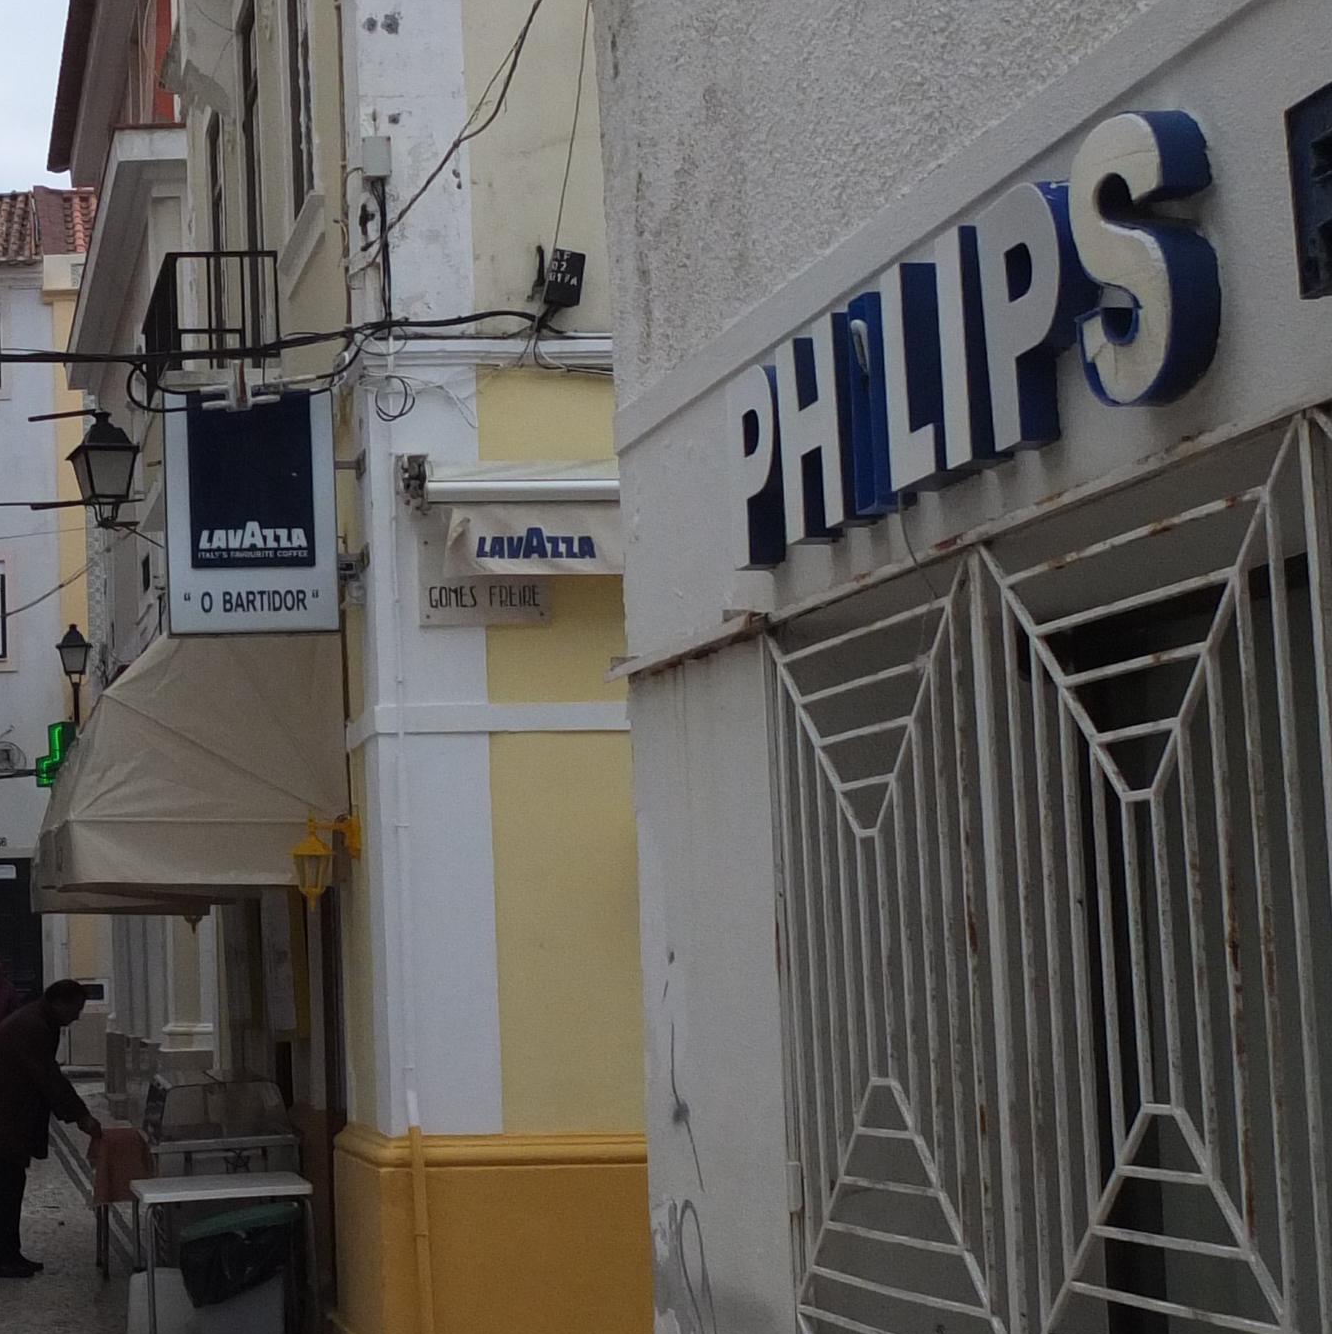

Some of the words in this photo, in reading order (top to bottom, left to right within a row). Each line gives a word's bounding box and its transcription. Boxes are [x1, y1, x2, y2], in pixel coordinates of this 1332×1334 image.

[726, 110, 1221, 570] PHILIPS
[198, 521, 308, 550] LAVAZZA
[476, 527, 596, 559] LAVAZZA
[277, 550, 308, 558] COFFEE
[223, 589, 308, 613] BARTIDOR
[429, 585, 477, 608] GOMES
[489, 585, 540, 608] FREIRE
